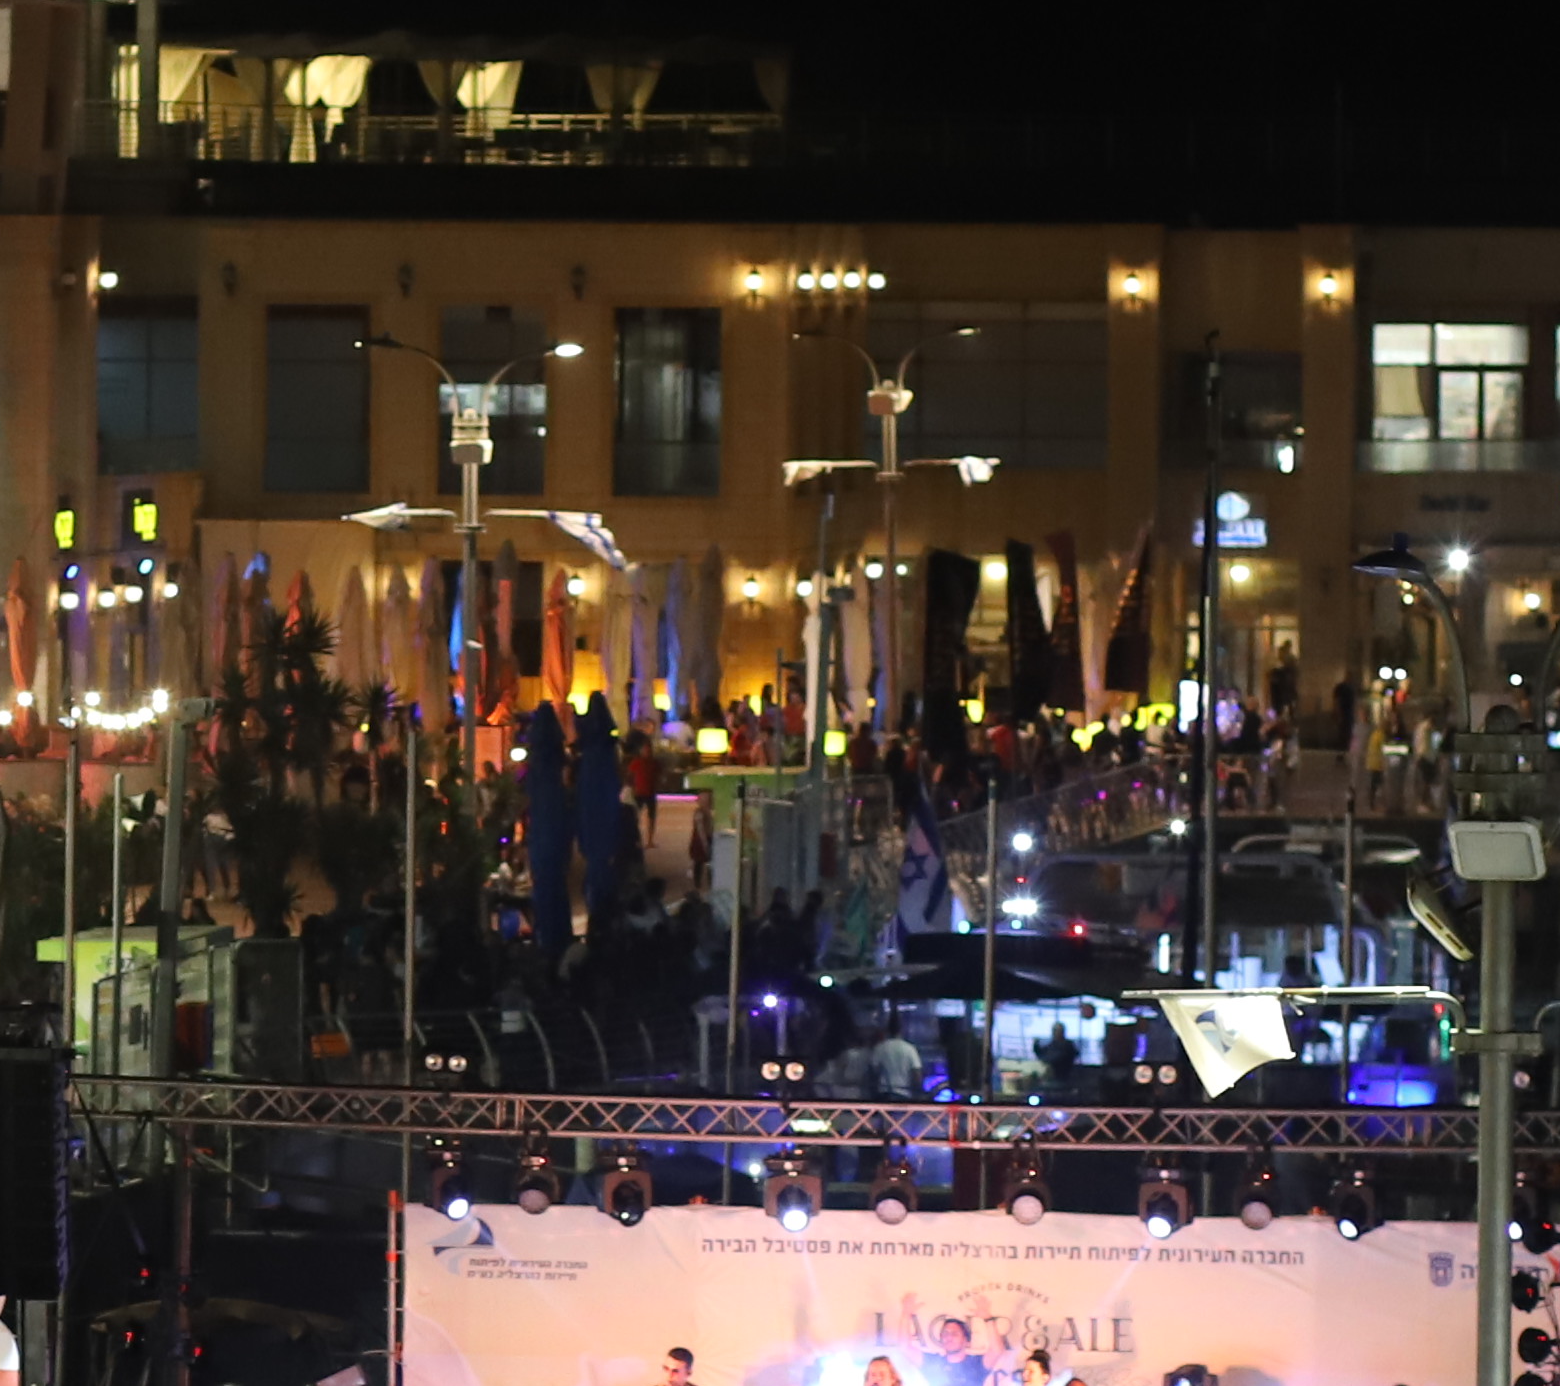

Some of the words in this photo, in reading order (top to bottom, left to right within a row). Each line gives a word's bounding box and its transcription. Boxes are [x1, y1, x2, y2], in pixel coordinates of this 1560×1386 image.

[701, 1237, 757, 1254] הבירה
[762, 1236, 832, 1255] פסטיבל
[837, 1240, 863, 1255] את
[869, 1241, 935, 1257] מארחת
[940, 1241, 1019, 1259] בהרצליה
[1024, 1245, 1082, 1260] תיירות
[1087, 1245, 1152, 1262] לפיתוח
[1158, 1247, 1237, 1263] העירונית
[1241, 1250, 1305, 1265] החברה
